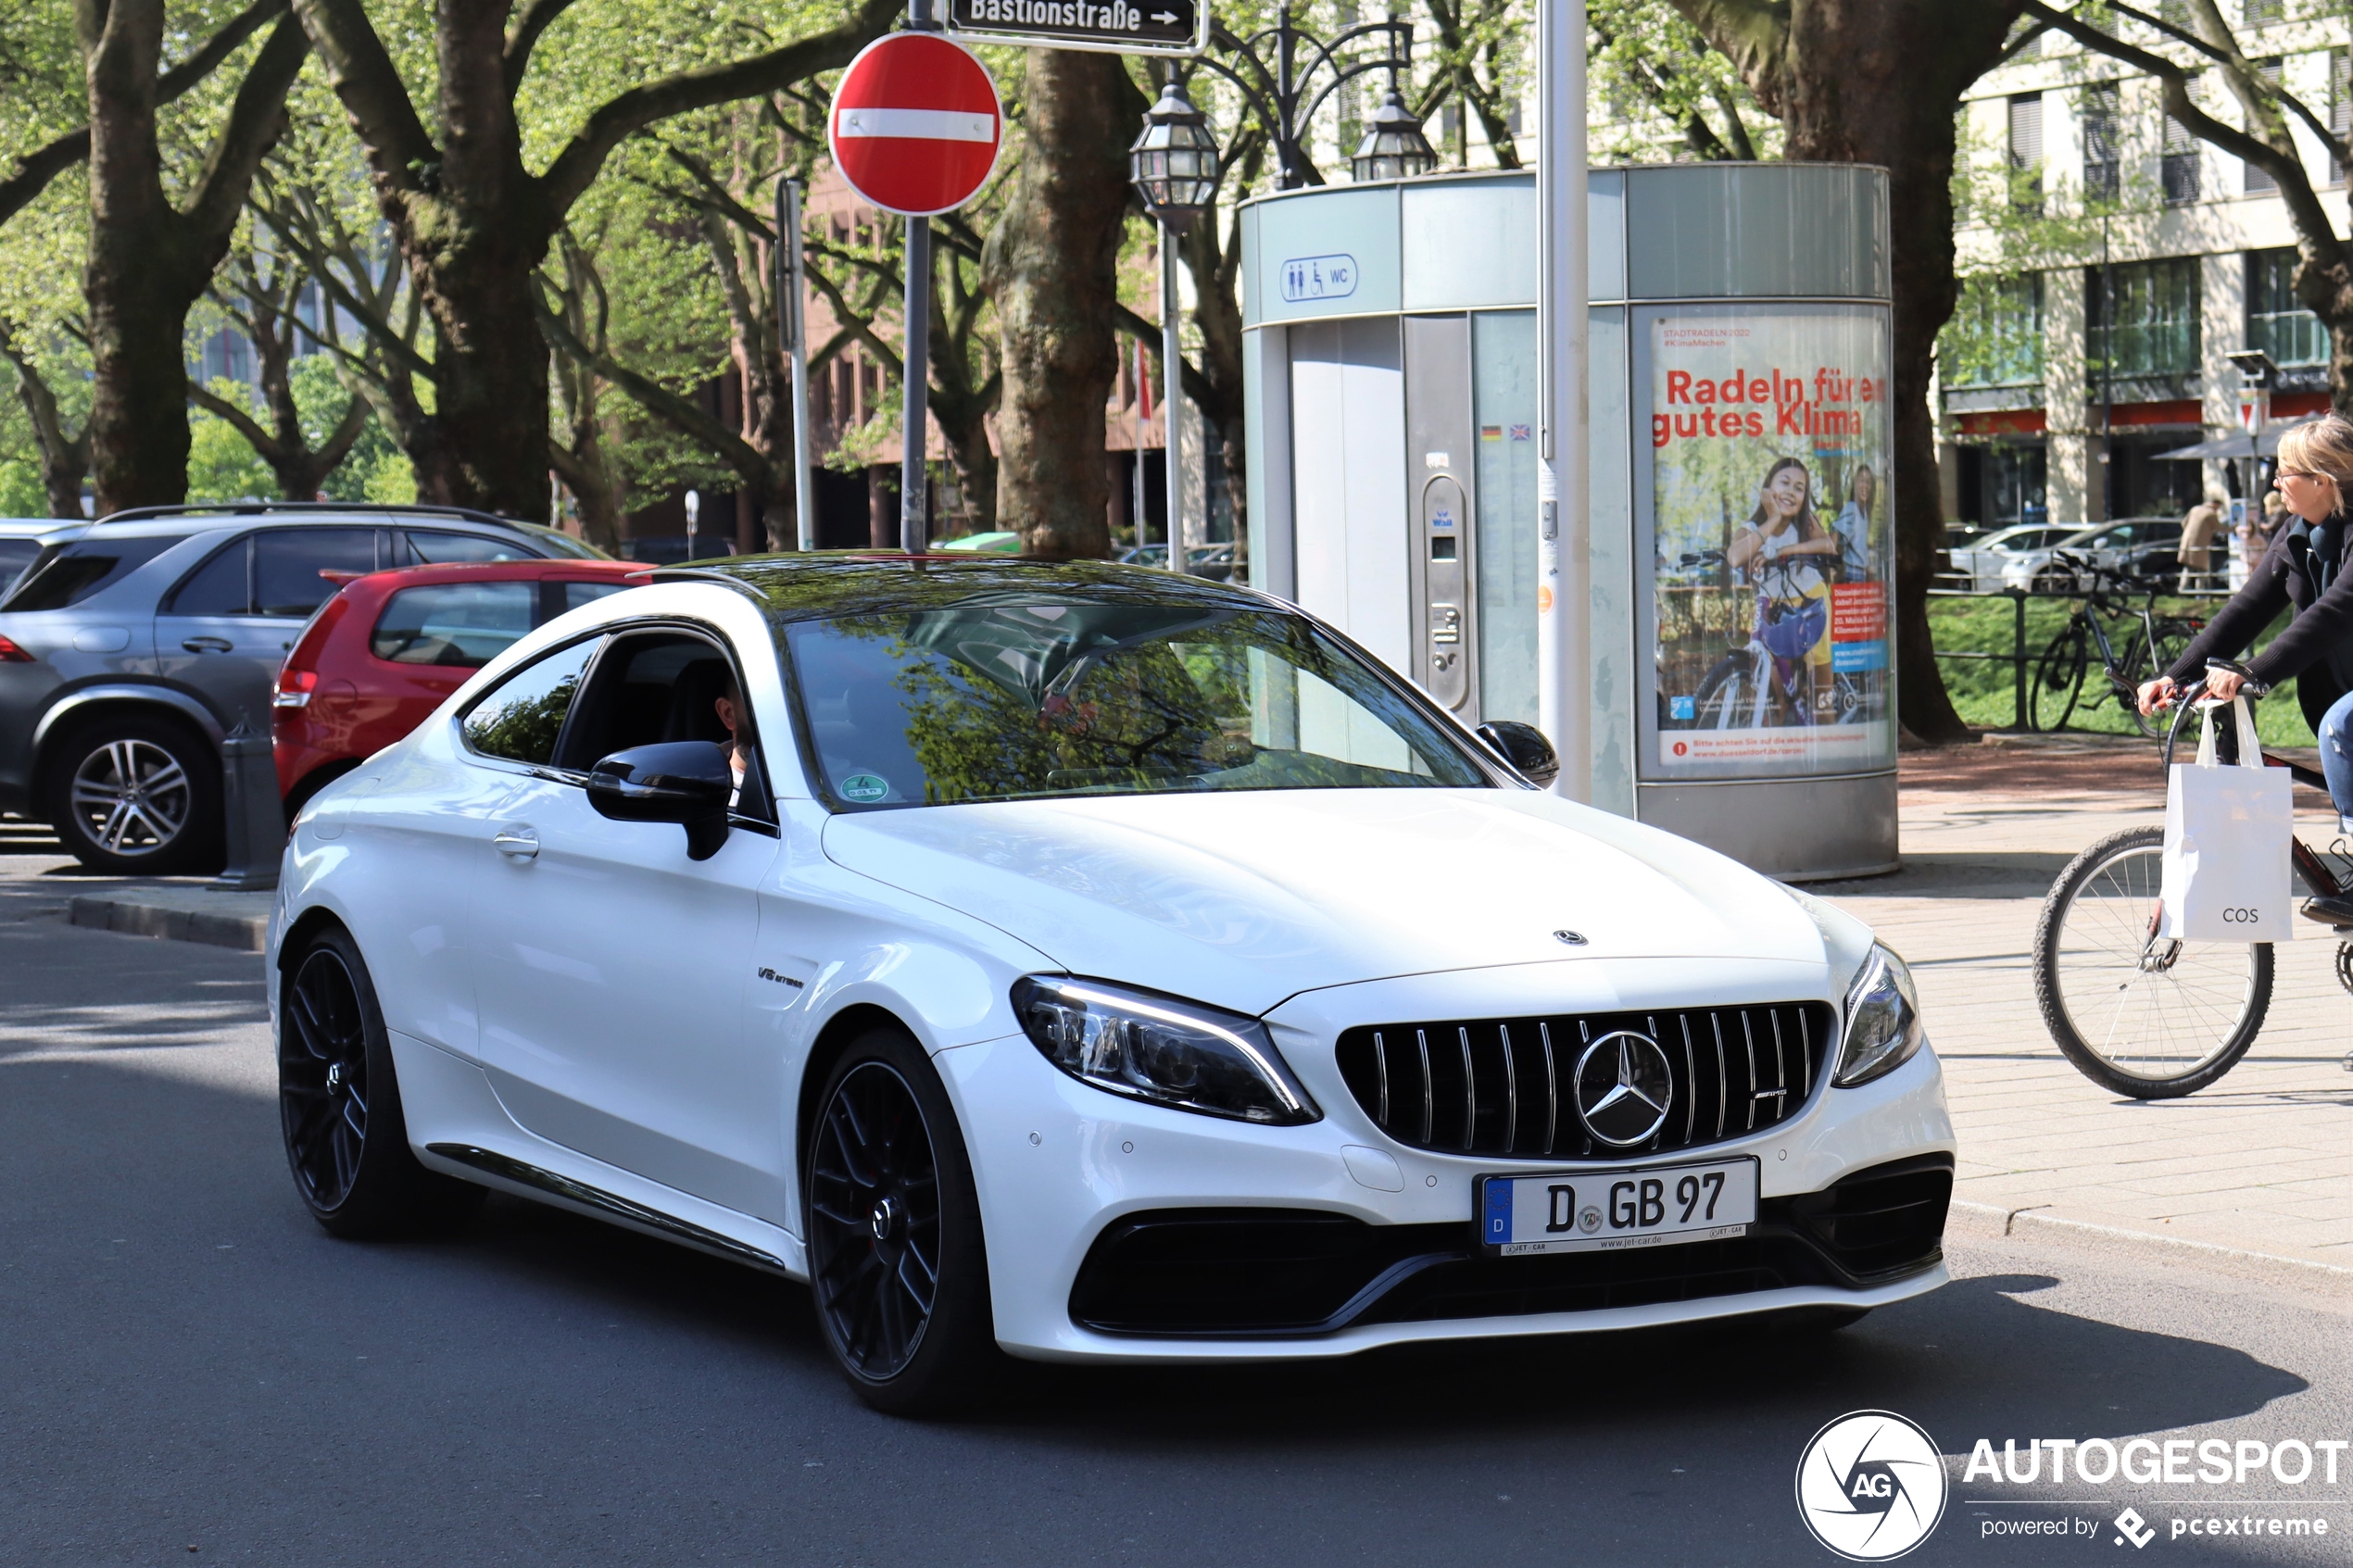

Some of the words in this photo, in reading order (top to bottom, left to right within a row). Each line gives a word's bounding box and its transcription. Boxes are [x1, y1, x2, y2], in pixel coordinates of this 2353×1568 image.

[970, 0, 1141, 31] Bastionstraße
[1329, 268, 1348, 283] WC
[1664, 329, 1727, 337] STADTRADELN
[1730, 329, 1751, 337] 2022
[1665, 339, 1726, 347] #KlimaMachen
[1667, 368, 1805, 405] Radeln
[1814, 367, 1856, 403] für
[1653, 406, 1764, 447] gutes
[1776, 400, 1861, 436] Klima
[1693, 739, 1714, 747] Bitte
[1745, 737, 1758, 746] Sie
[2222, 908, 2259, 923] COS
[758, 967, 776, 981] V8
[1545, 1184, 1576, 1233] D
[1608, 1177, 1666, 1229] GB
[1676, 1171, 1726, 1223] 97
[1492, 1219, 1504, 1233] D
[1600, 1236, 1662, 1248] www.jet-car.de
